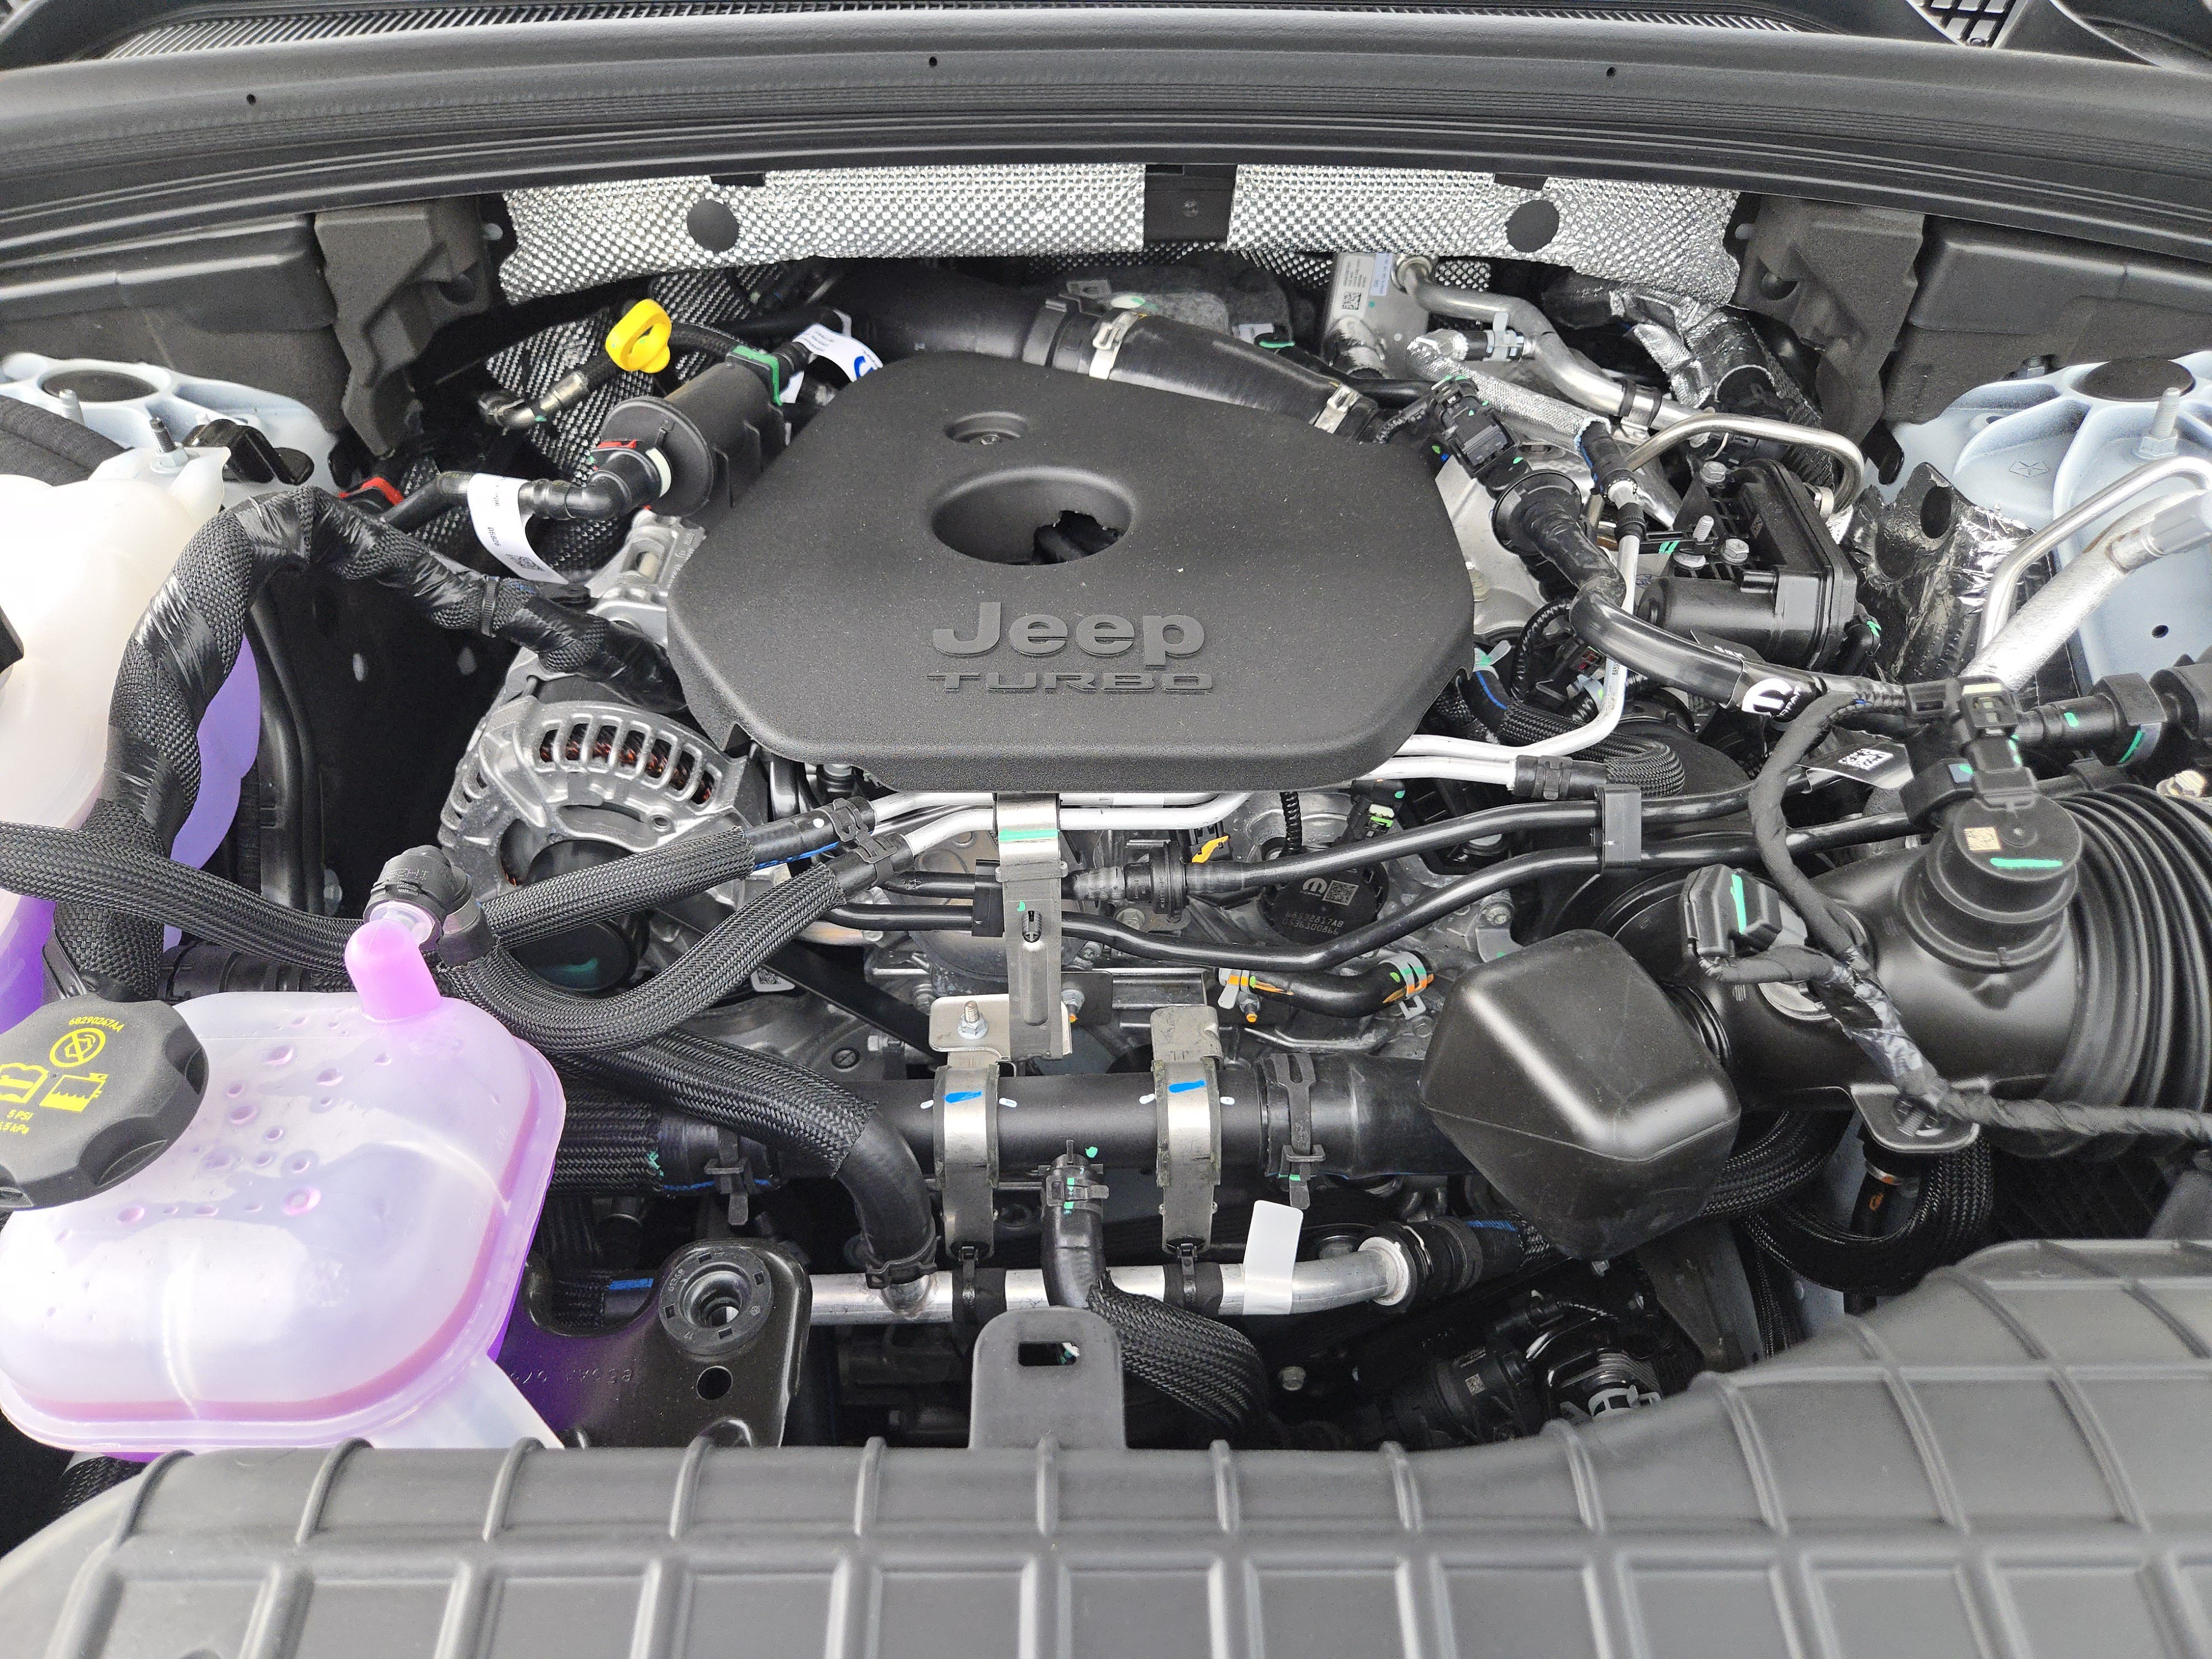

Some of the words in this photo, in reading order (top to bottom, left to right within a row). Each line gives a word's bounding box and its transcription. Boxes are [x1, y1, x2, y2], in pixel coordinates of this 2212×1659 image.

[932, 601, 1204, 669] Jeep
[927, 672, 1213, 695] TURBO
[7, 1109, 15, 1119] 5
[14, 1111, 34, 1121] PSI
[10, 1122, 30, 1135] kPa
